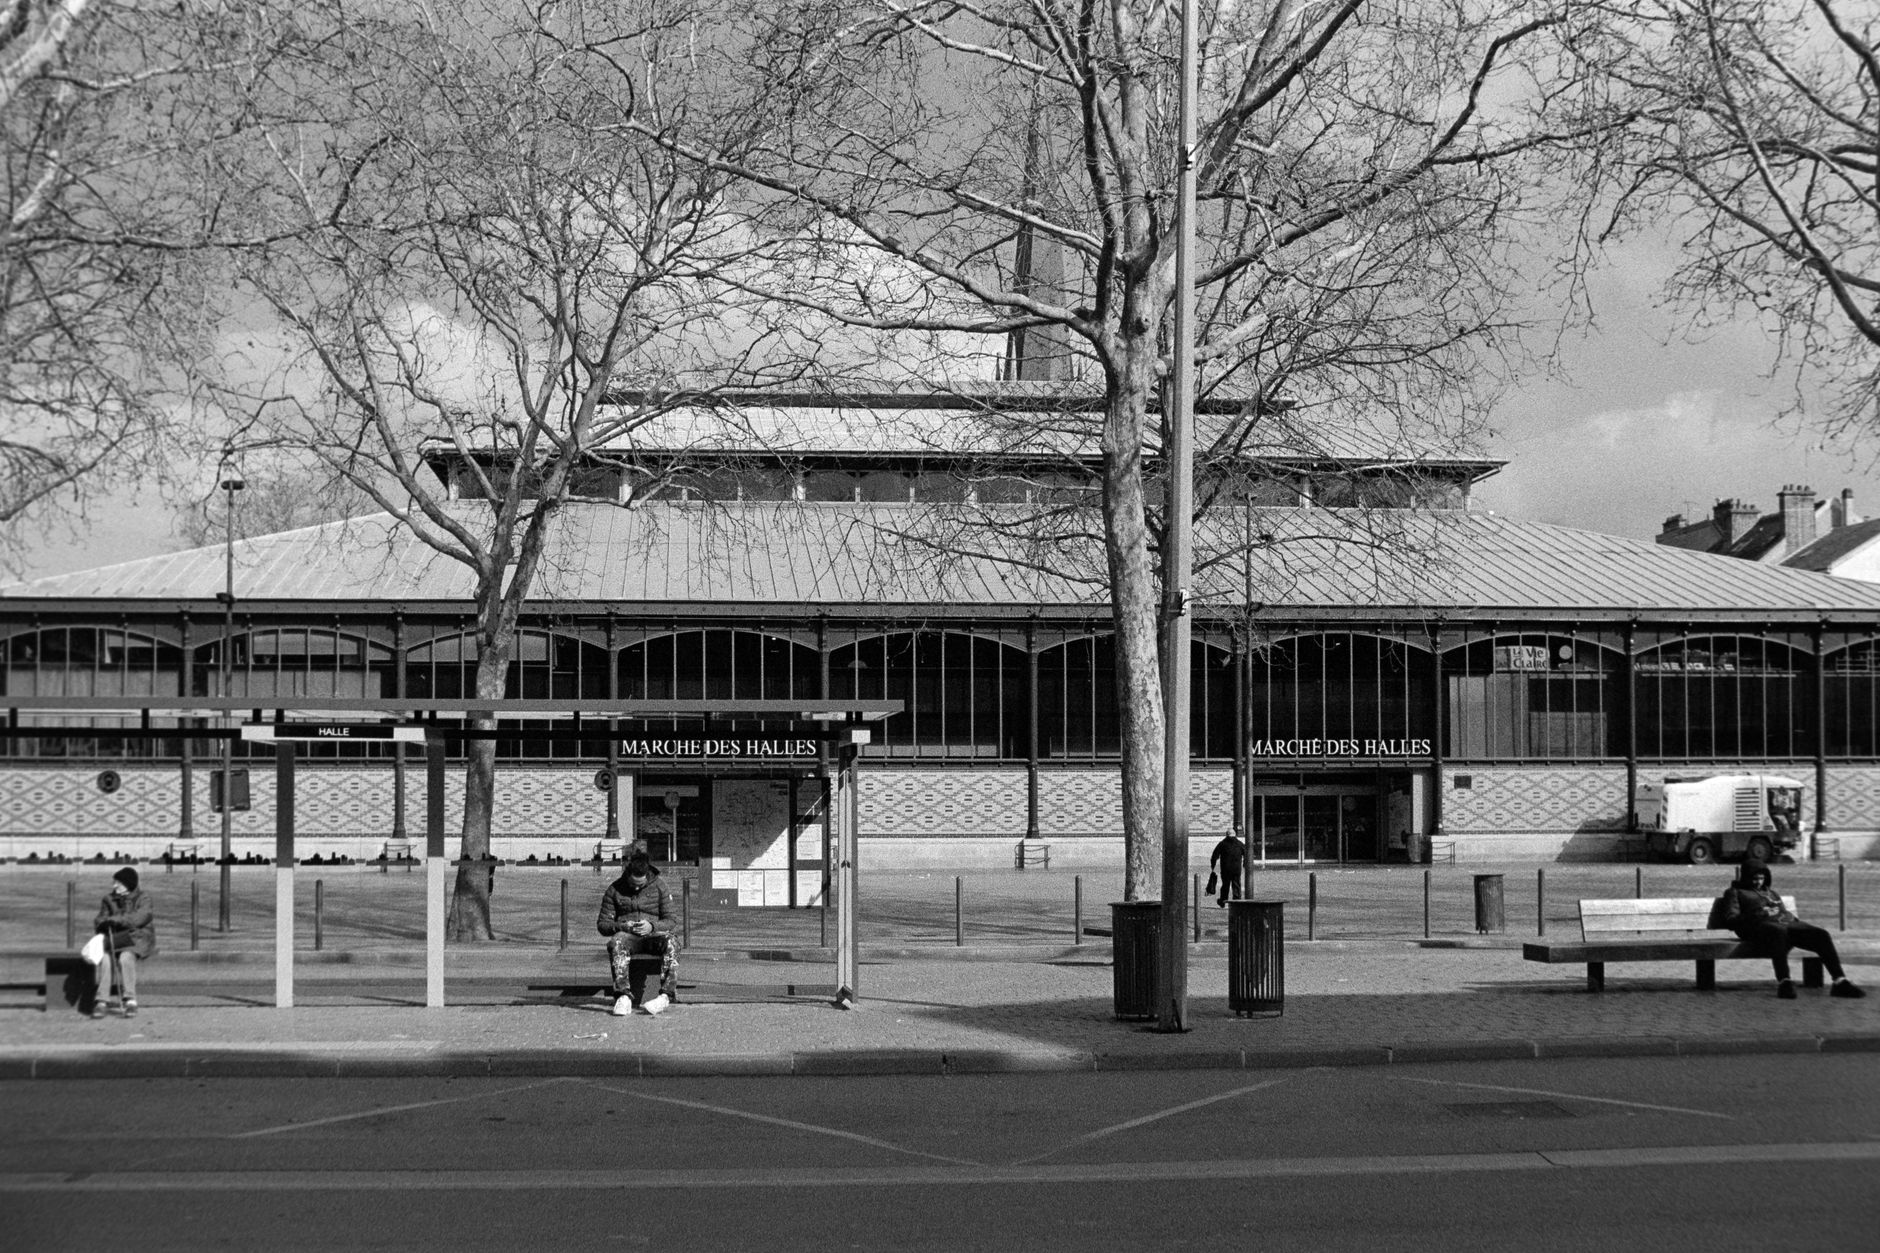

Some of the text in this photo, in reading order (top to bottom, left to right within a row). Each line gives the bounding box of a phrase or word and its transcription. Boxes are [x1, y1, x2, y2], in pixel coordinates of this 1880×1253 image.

[1526, 647, 1544, 658] Vie
[318, 727, 350, 736] HALLE
[706, 739, 741, 755] DES
[746, 739, 817, 755] HALLES
[1250, 737, 1431, 755] MARCHÉ DES HALLES
